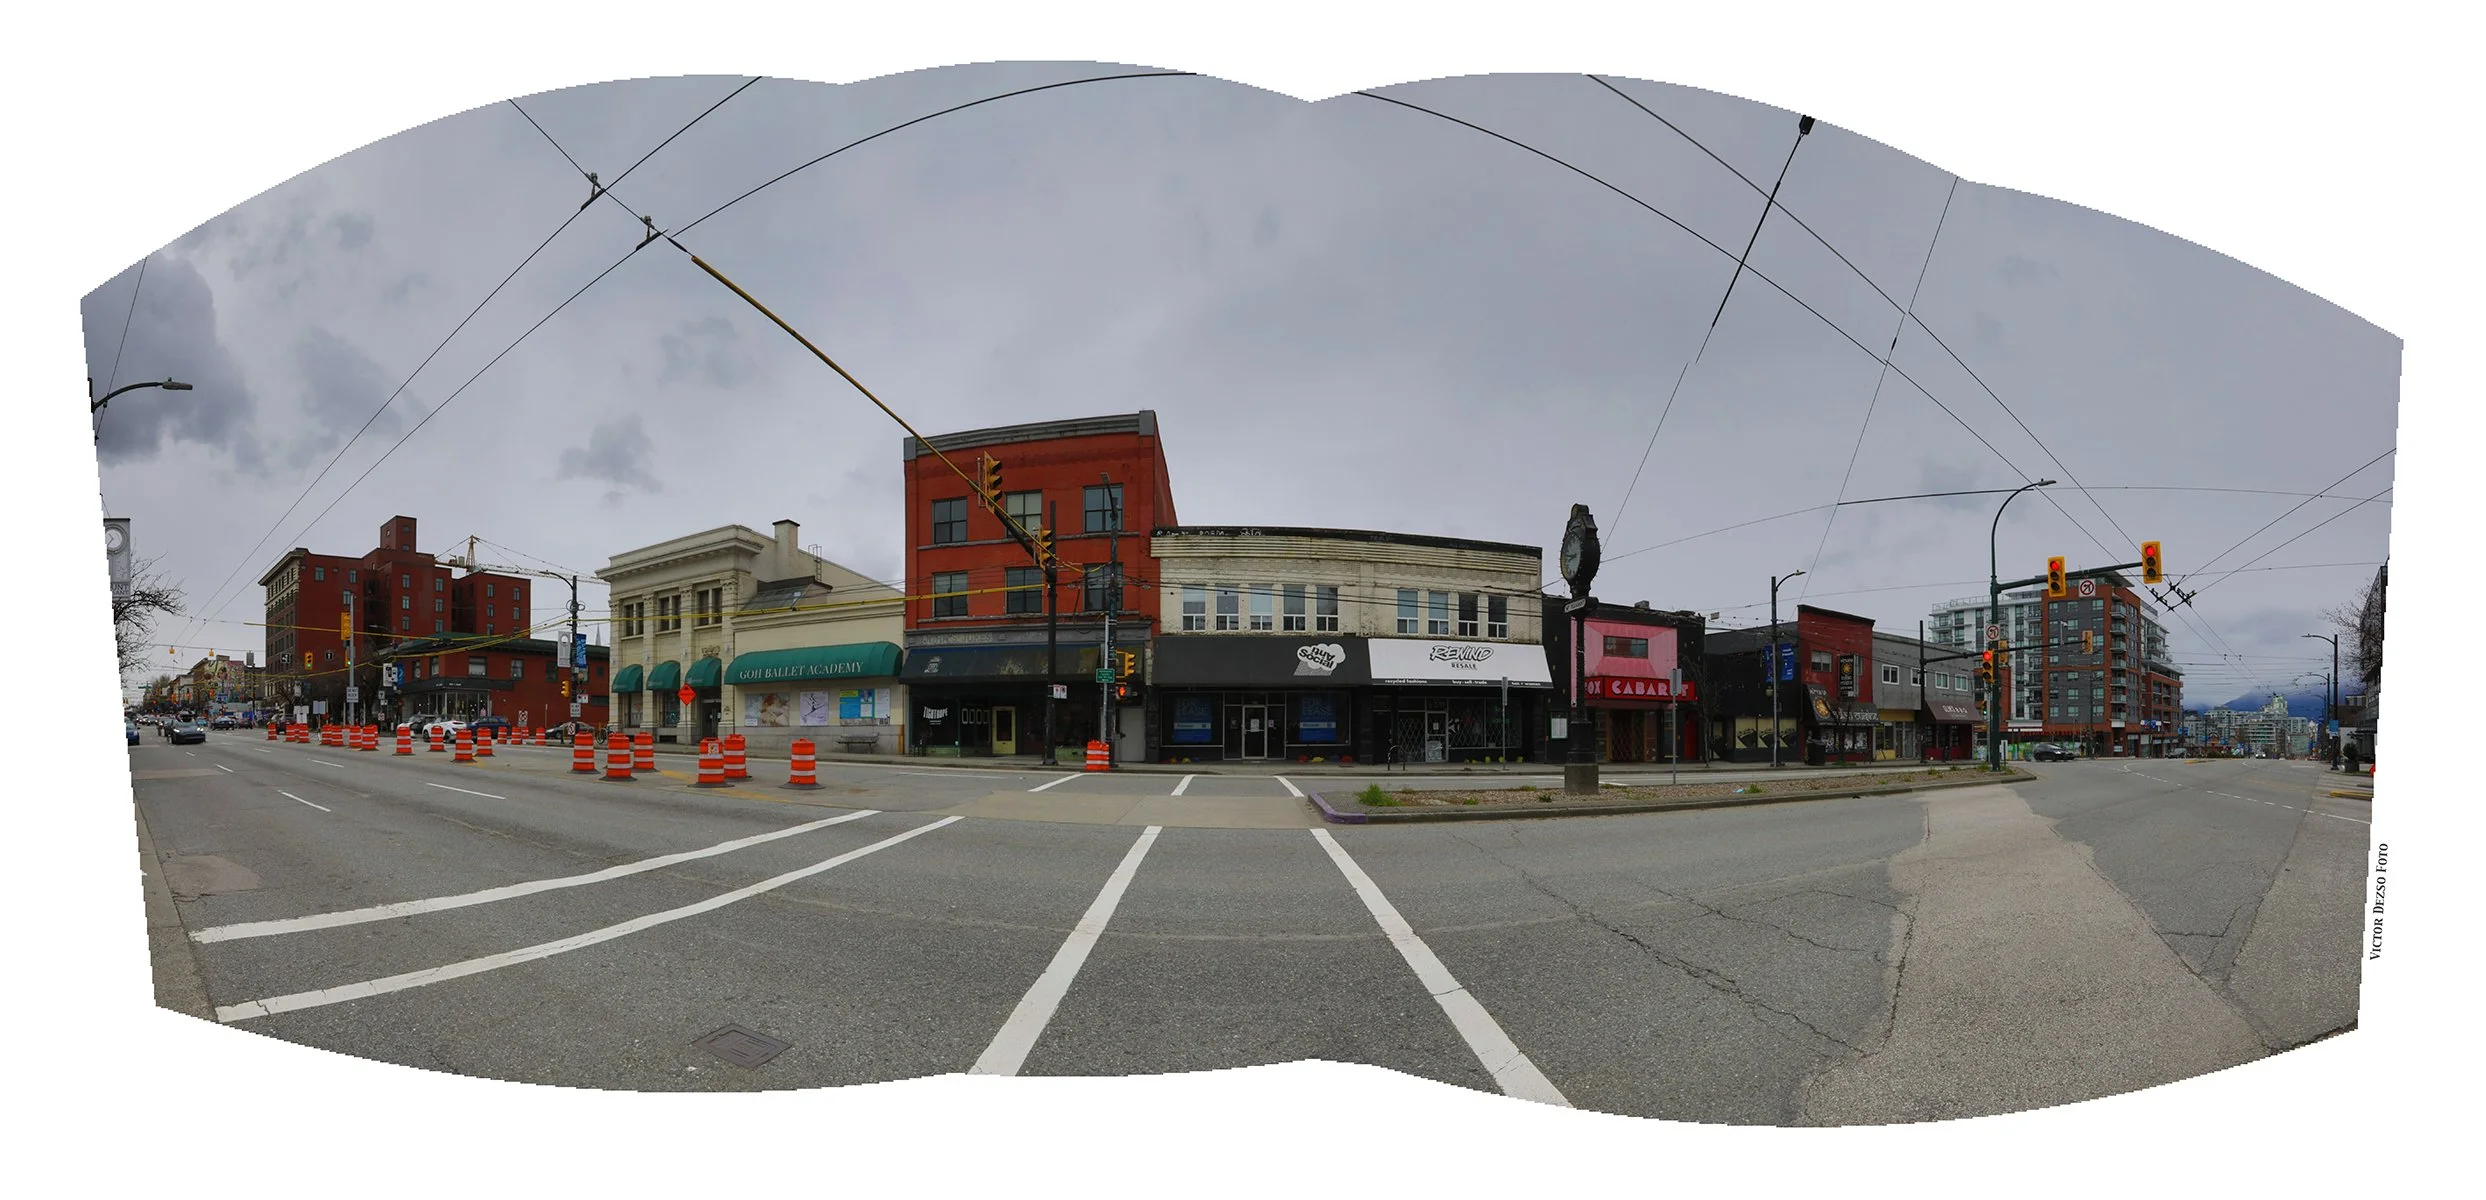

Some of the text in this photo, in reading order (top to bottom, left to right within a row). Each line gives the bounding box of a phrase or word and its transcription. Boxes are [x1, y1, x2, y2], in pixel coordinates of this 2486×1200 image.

[1299, 648, 1334, 668] Social
[1429, 645, 1494, 661] REWIND
[739, 661, 864, 680] GOH BALLET ACADEMY
[1451, 662, 1477, 670] RESALE
[1584, 680, 1689, 697] OX CABART
